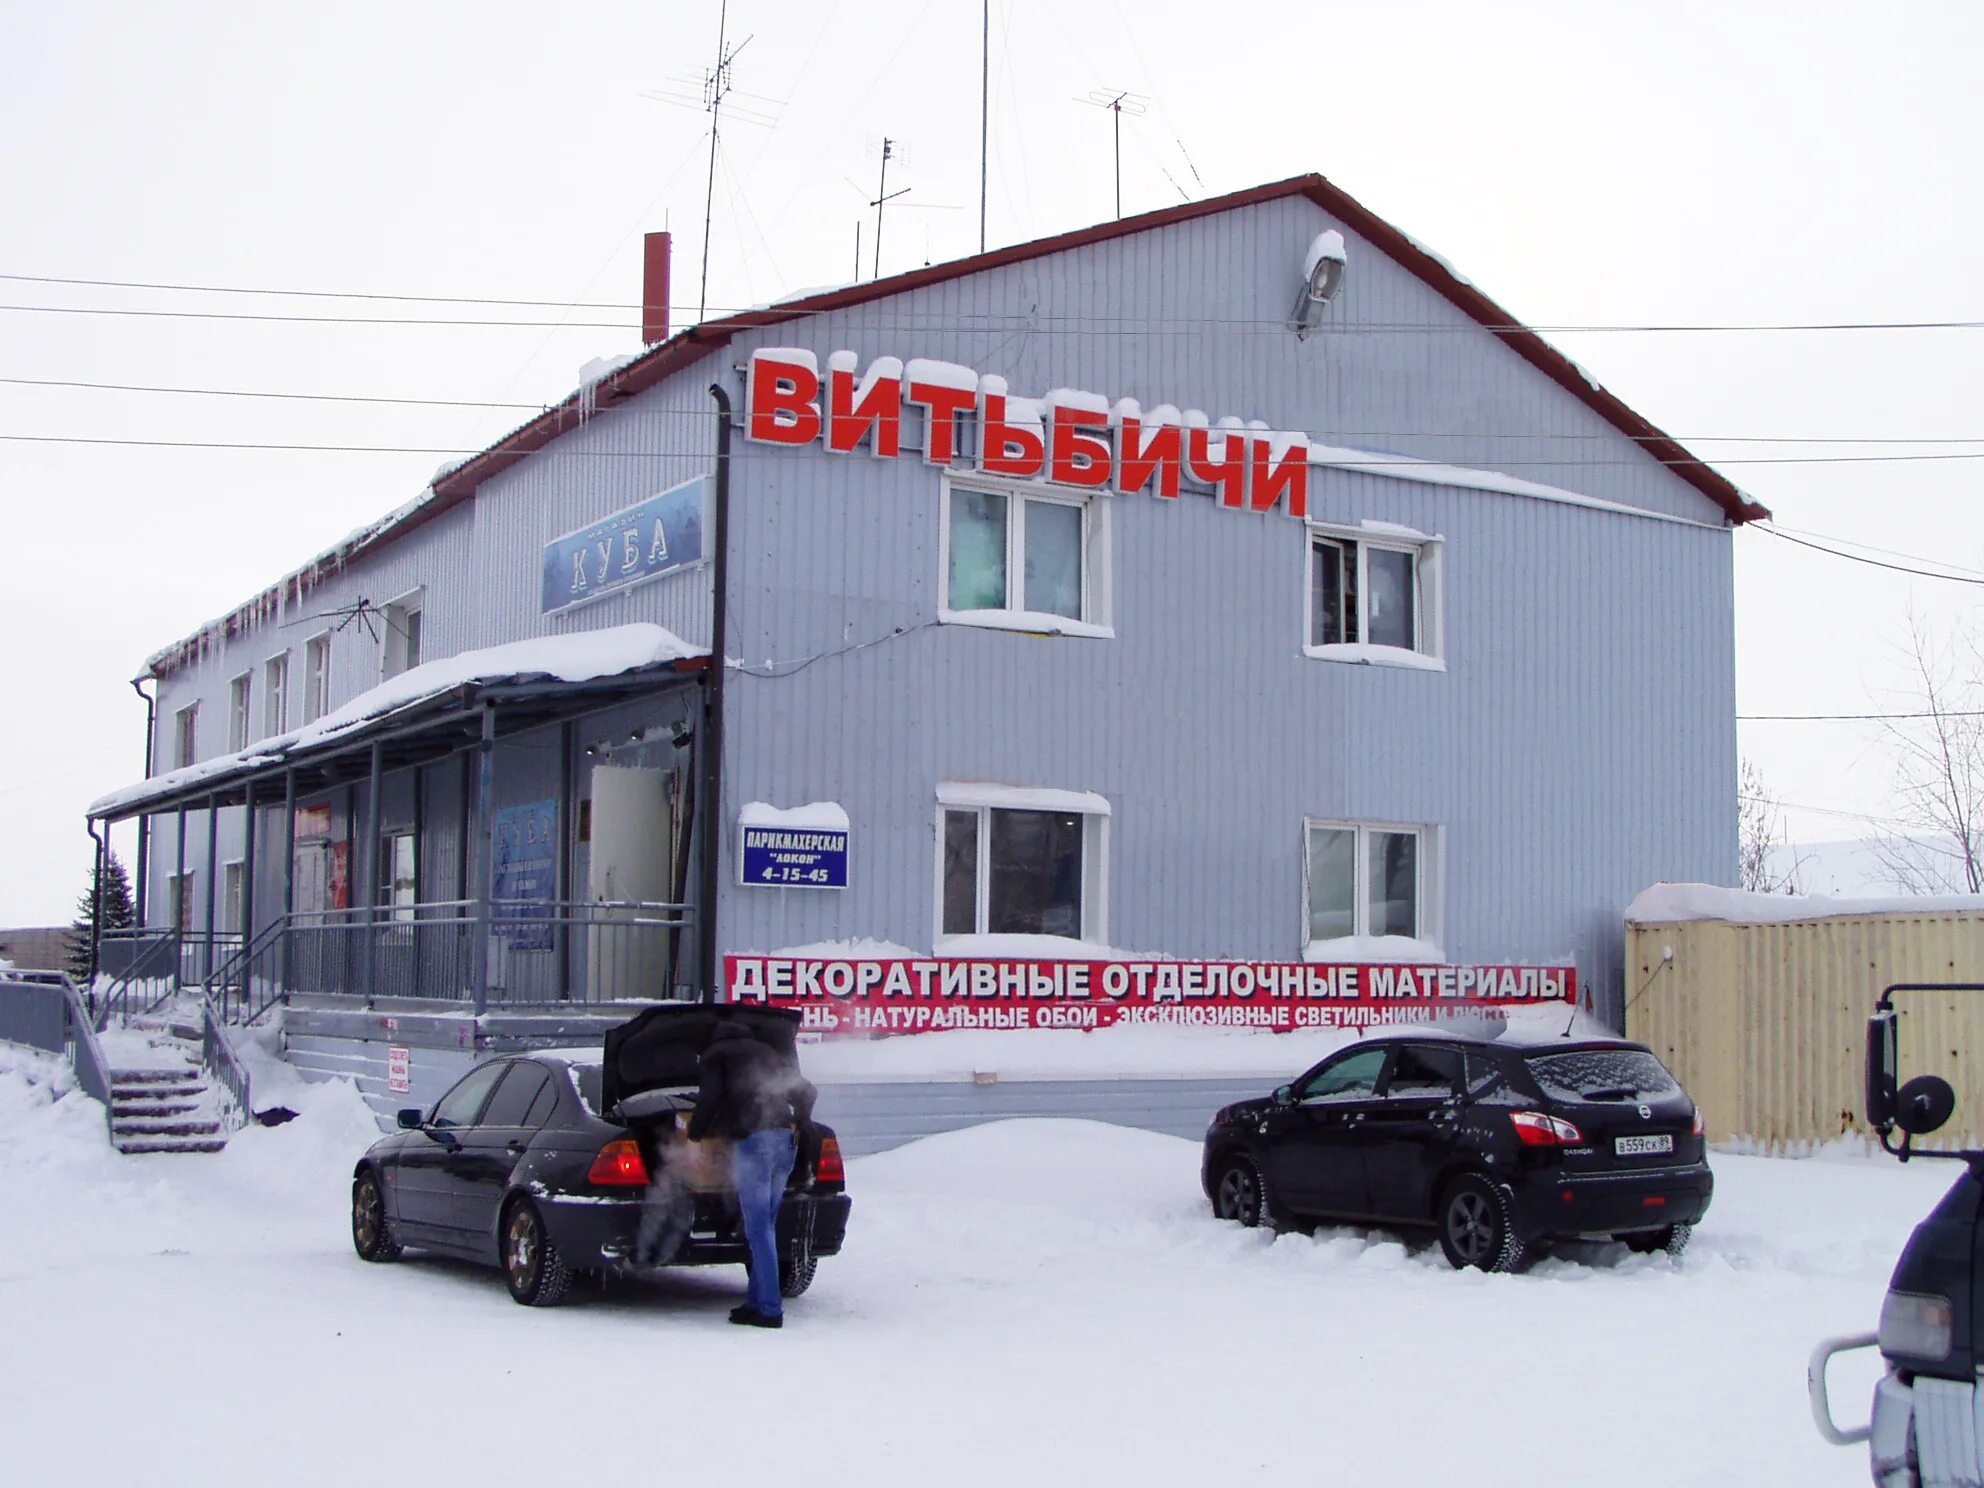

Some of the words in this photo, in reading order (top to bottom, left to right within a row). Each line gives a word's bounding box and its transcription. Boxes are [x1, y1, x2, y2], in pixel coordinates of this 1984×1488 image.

[747, 355, 1308, 518] ВИТЬБИЧИ
[570, 518, 669, 593] КУБА
[746, 831, 845, 852] ПАРИКМАХЕРСКАЯ
[762, 866, 828, 882] 4-15-45
[731, 960, 1090, 1001] ДЕКОРАТИВНЫЕ
[1102, 963, 1359, 1002] ОТДЕЛОЧНЫЕ
[1370, 967, 1566, 998] МАТЕРИАЛЫ
[855, 1006, 1029, 1028] НАТУРАЛЬНЫЕ
[1036, 1006, 1097, 1027] ОБОИ
[1117, 1006, 1289, 1026] ЭКСКЛЮЗИВНЫЕ
[1295, 1006, 1430, 1025] СВЕТИЛЬНИКИ
